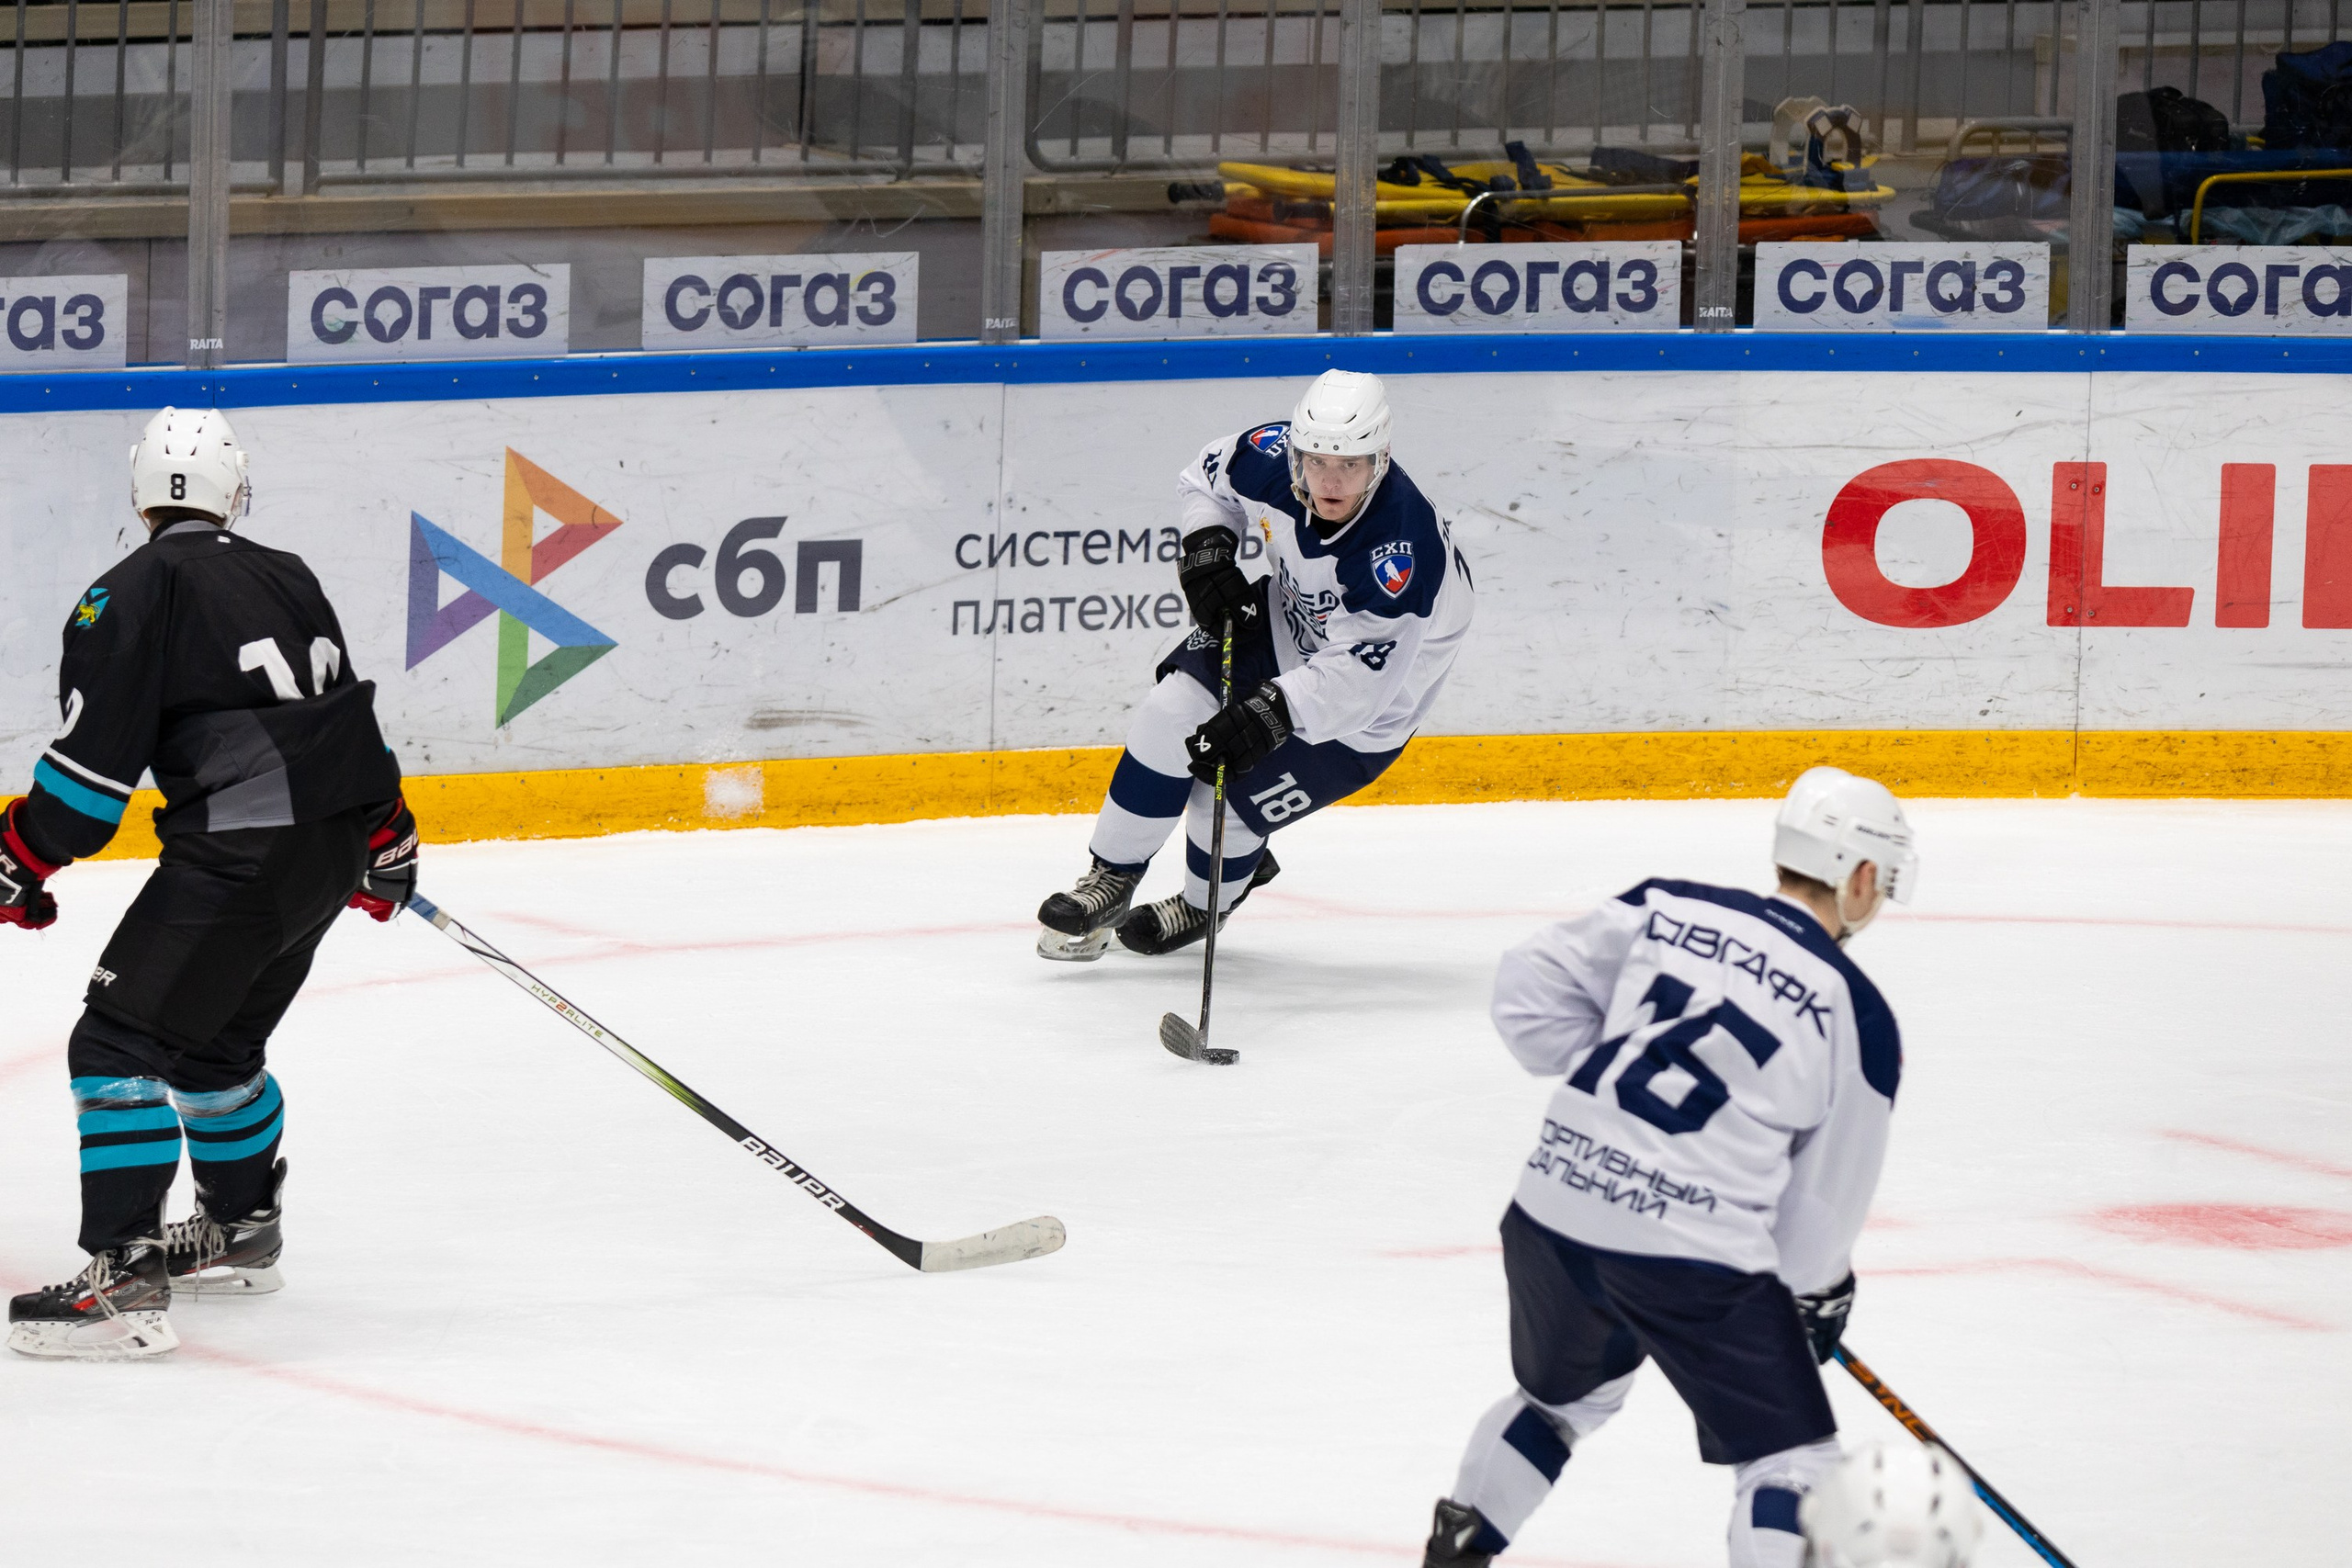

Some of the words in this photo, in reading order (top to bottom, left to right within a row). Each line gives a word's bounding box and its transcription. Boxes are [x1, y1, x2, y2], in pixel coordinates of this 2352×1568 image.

[189, 338, 224, 350] RAITA
[170, 472, 187, 501] 8
[644, 515, 863, 620] сбп
[955, 525, 1182, 570] система
[951, 592, 1198, 636] платеже
[1250, 772, 1312, 822] 18
[531, 984, 604, 1038] HYP2RLITE
[1566, 971, 1783, 1136] 16
[739, 1135, 846, 1212] BAUER
